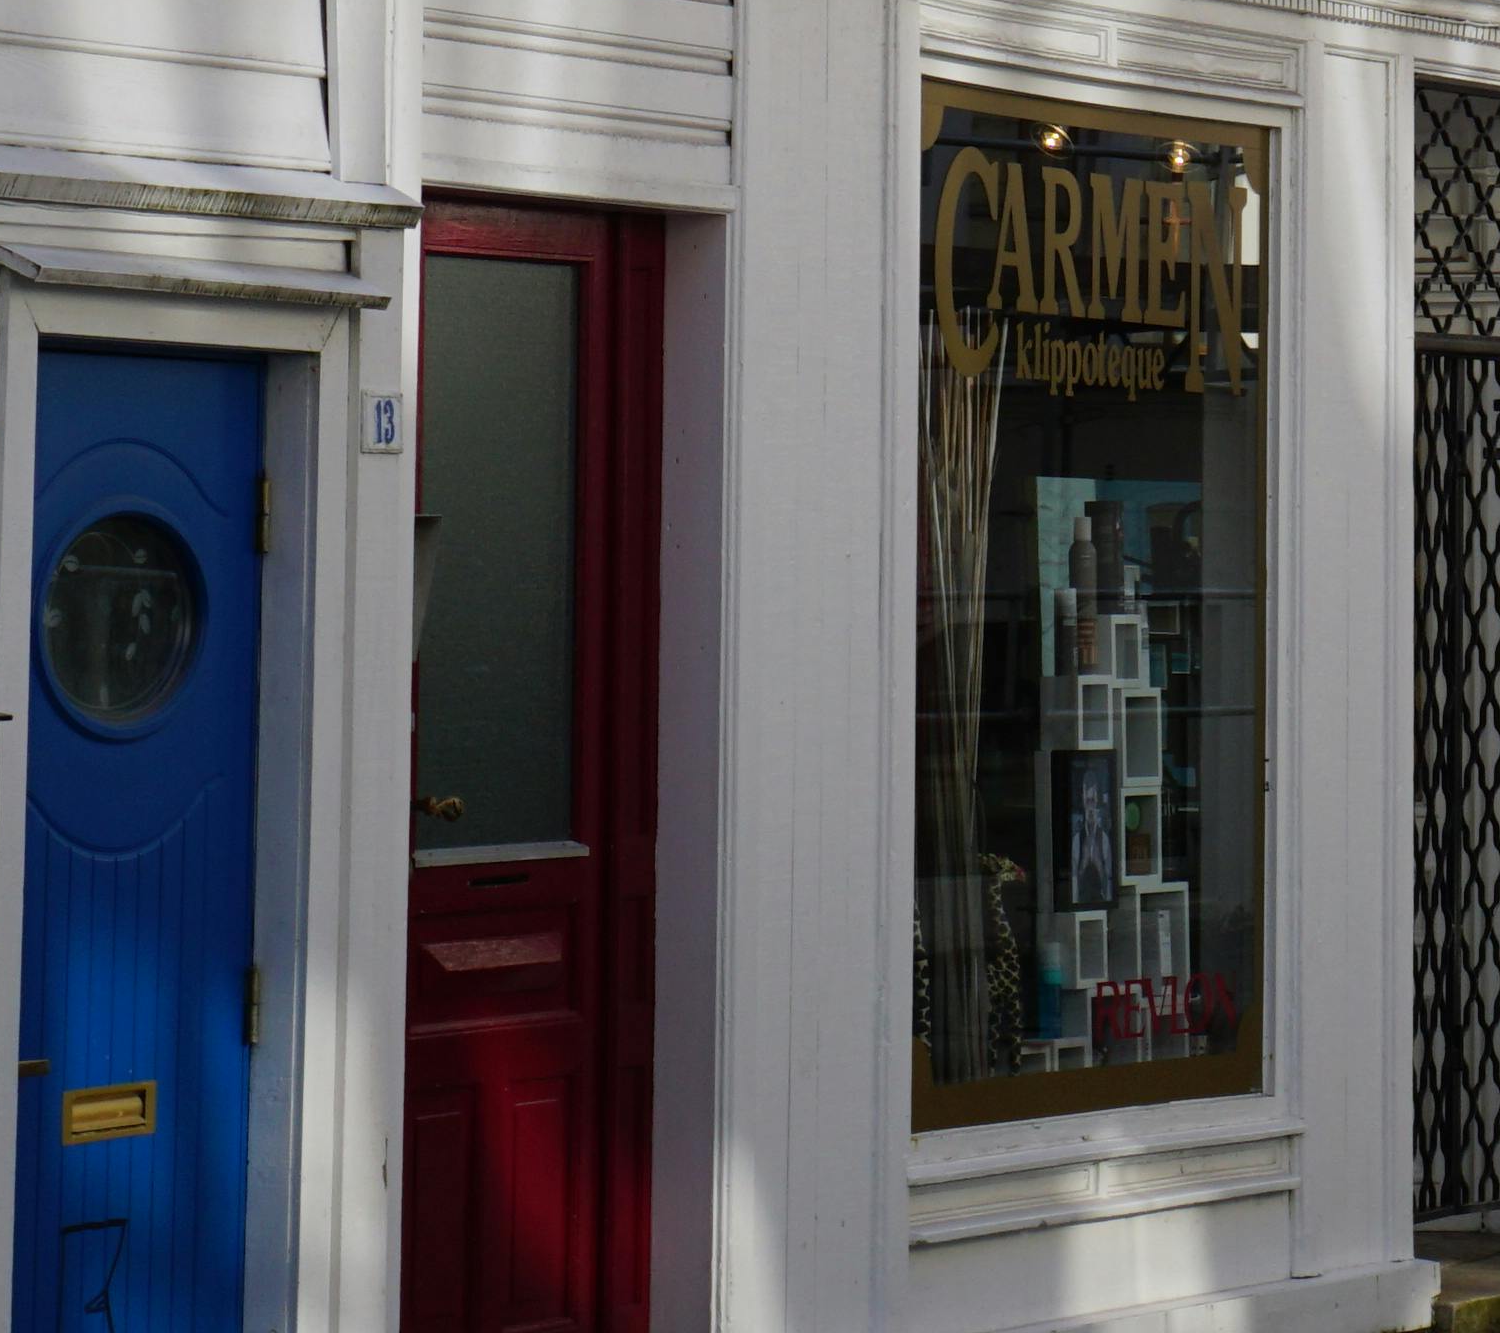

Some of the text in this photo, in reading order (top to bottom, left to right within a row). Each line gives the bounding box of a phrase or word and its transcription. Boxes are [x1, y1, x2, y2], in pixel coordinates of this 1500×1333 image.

[936, 146, 1248, 397] CARMEN
[1015, 321, 1166, 402] klippoteque
[374, 399, 395, 444] 13
[1095, 972, 1238, 1041] REVLON
